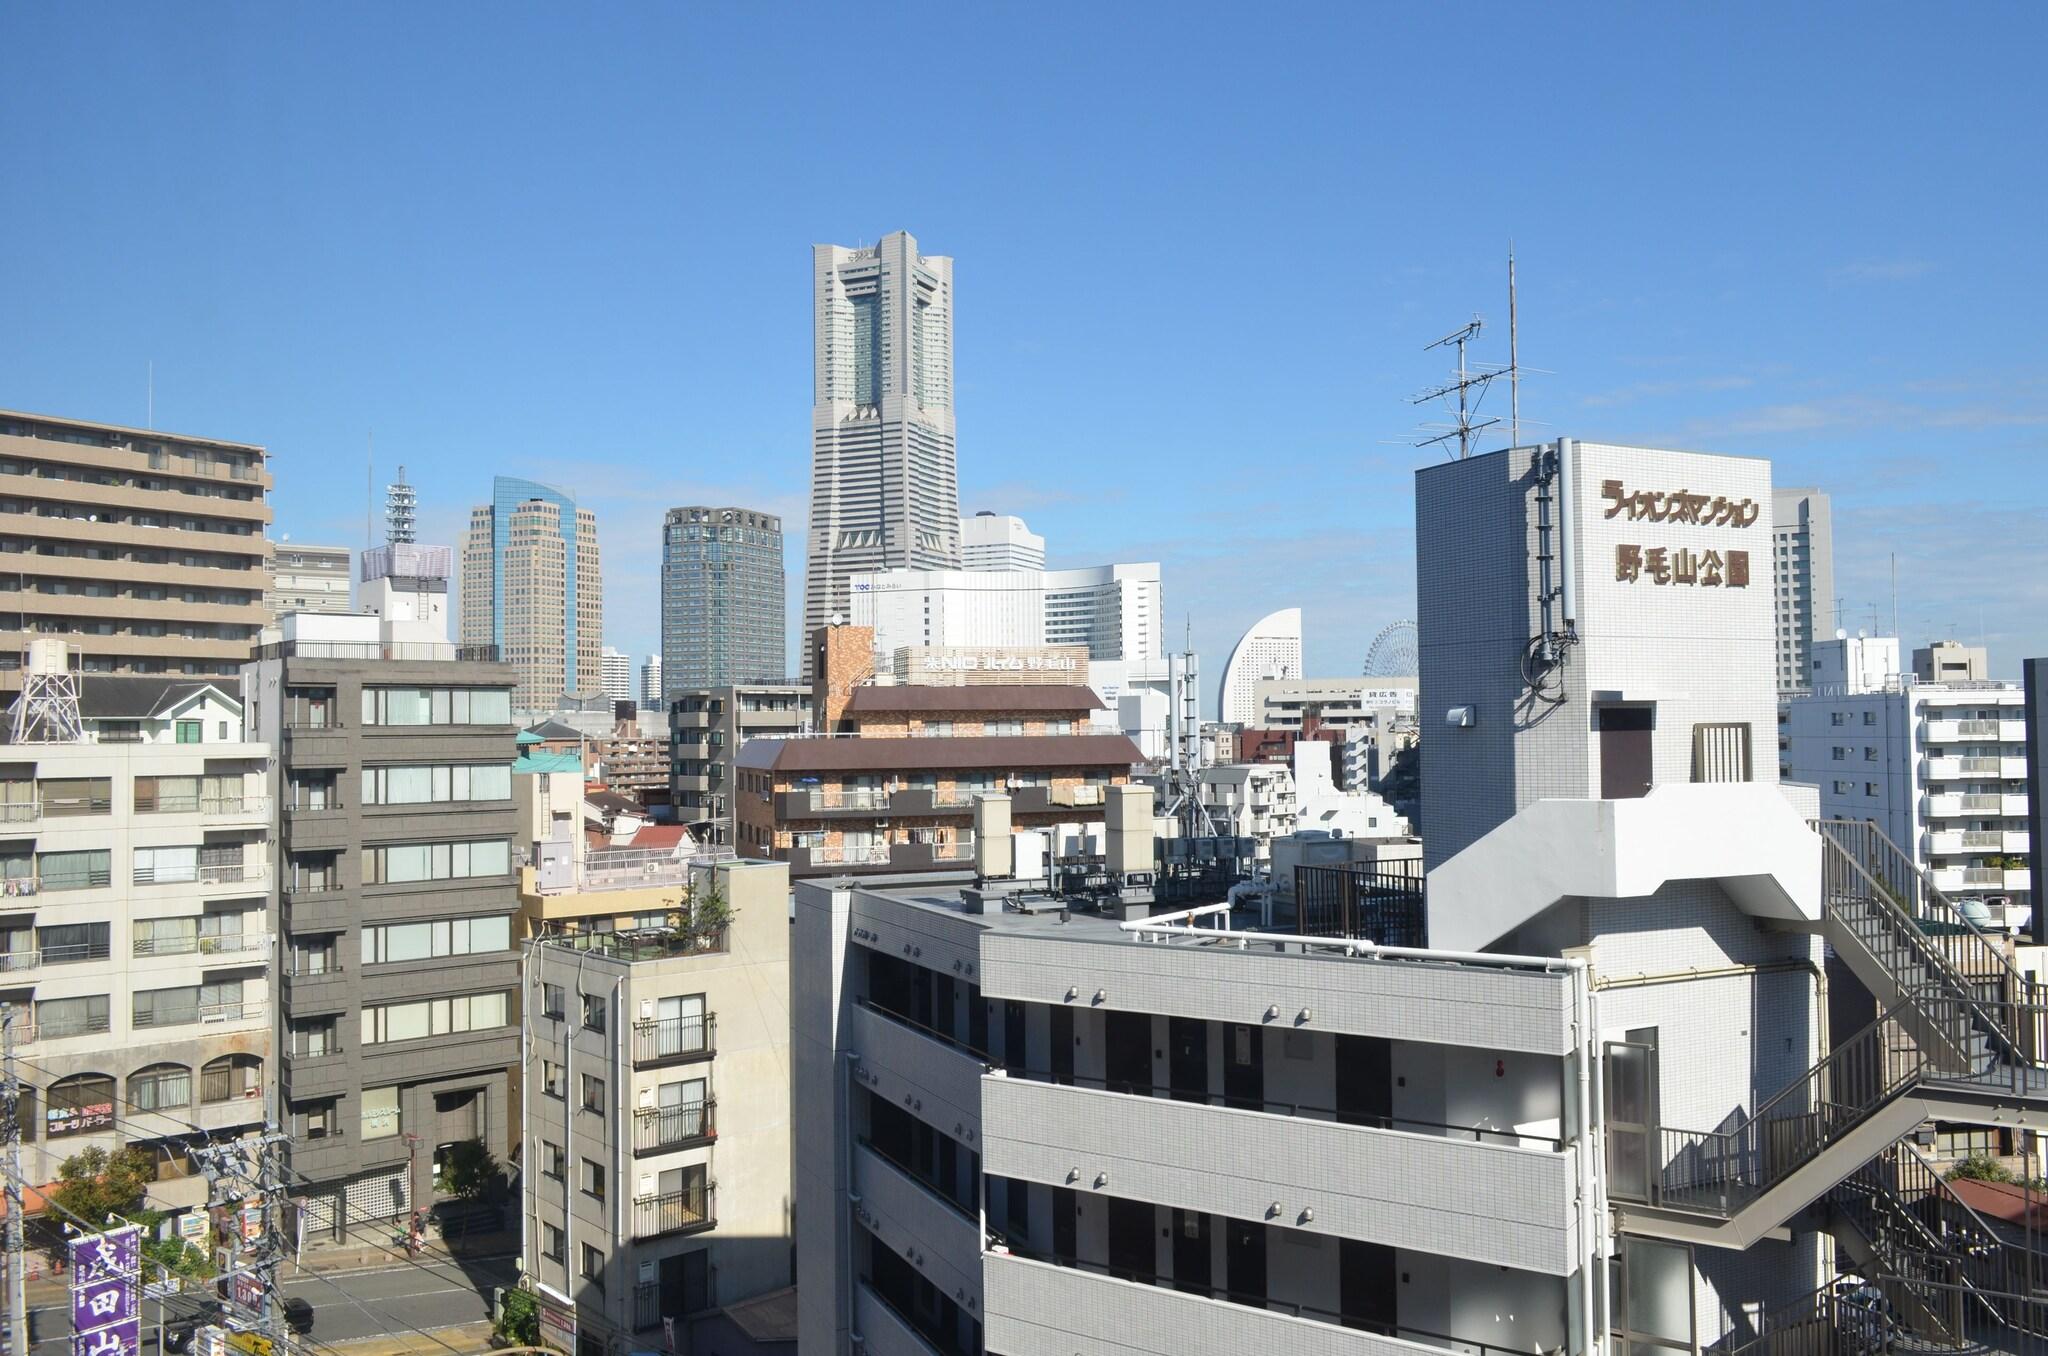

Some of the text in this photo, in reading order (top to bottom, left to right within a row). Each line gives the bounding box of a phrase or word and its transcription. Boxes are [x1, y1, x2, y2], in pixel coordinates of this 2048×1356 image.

[1601, 479, 1760, 528] ライオンズマンション
[854, 583, 870, 591] TOC
[1615, 544, 1750, 589] 野毛山公園
